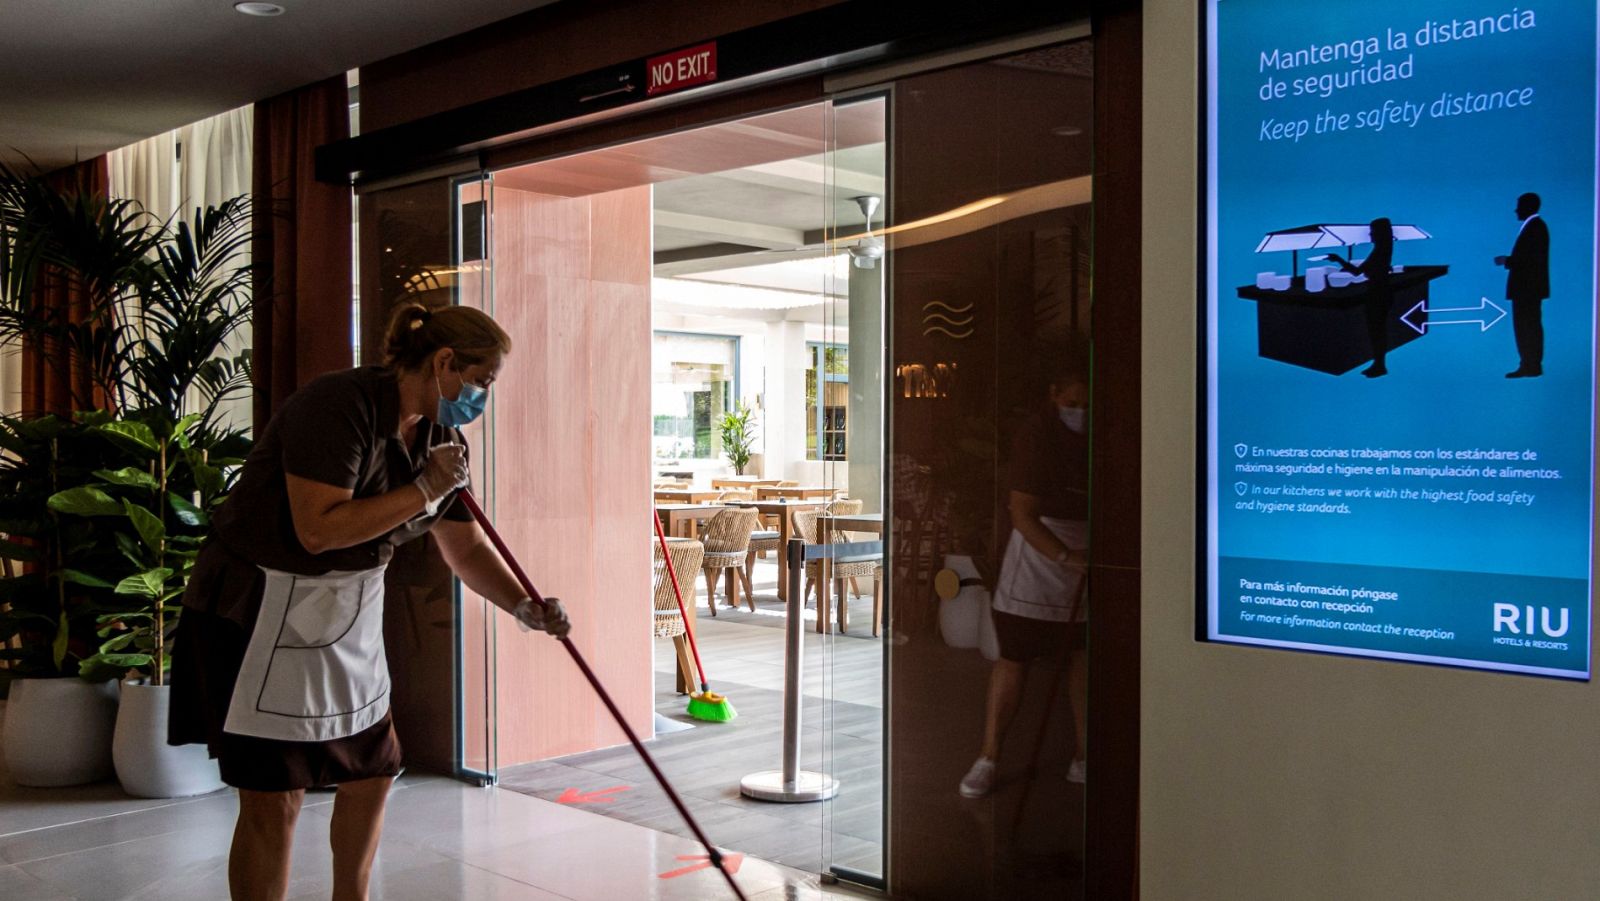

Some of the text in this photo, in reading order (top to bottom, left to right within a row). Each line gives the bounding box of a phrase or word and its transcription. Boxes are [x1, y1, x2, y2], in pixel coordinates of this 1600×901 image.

[1259, 8, 1536, 72] Mantenga la distancia
[652, 51, 711, 87] NO EXIT
[1259, 54, 1413, 100] de seguridad
[1259, 87, 1534, 142] Keep the safety distance
[1252, 446, 1537, 461] En nuestras cocinas trabajamos con los estándares de
[1235, 462, 1562, 479] máxima seguridad e higiene en la manipulación de alimentos.
[1235, 500, 1351, 514] and hygiene standards.
[1251, 485, 1535, 506] In our kitchens we work with the highest food safety
[1240, 578, 1398, 601] Para más información póngase
[1240, 595, 1373, 614] en contacto con recepción
[1240, 611, 1454, 640] For more information contact the reception
[1493, 602, 1569, 638] RIU
[1493, 637, 1568, 651] HOTELS & RESORTS
